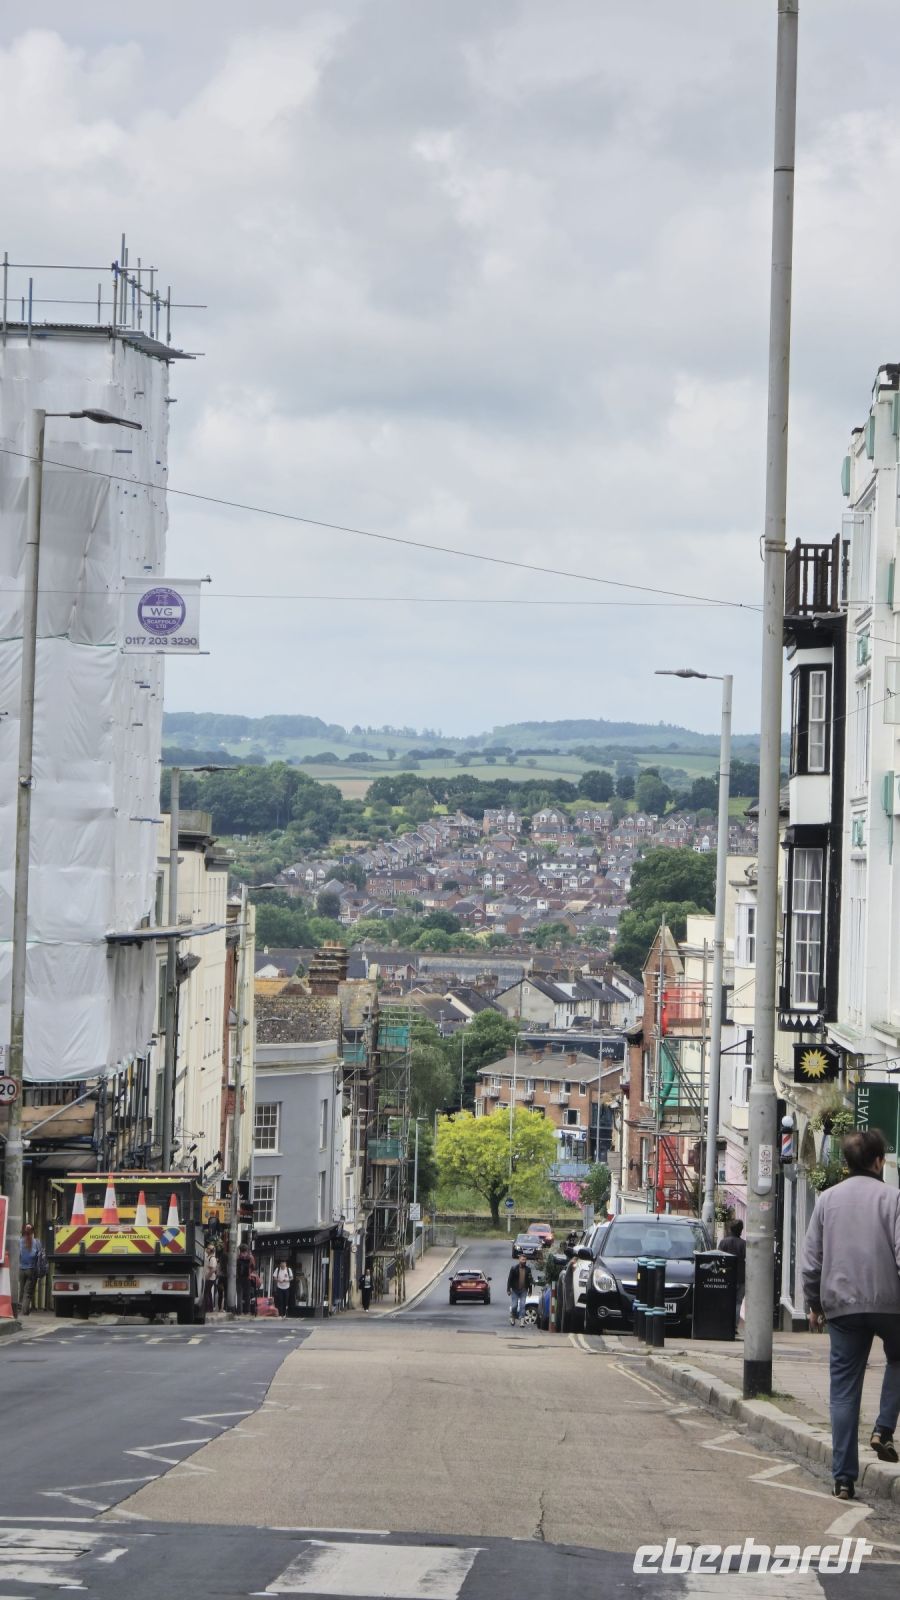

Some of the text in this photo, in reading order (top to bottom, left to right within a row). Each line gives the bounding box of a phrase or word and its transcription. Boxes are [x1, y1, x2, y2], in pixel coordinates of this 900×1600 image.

[150, 607, 173, 616] WG
[125, 636, 198, 646] 0117 203 3290
[0, 1084, 16, 1095] 20
